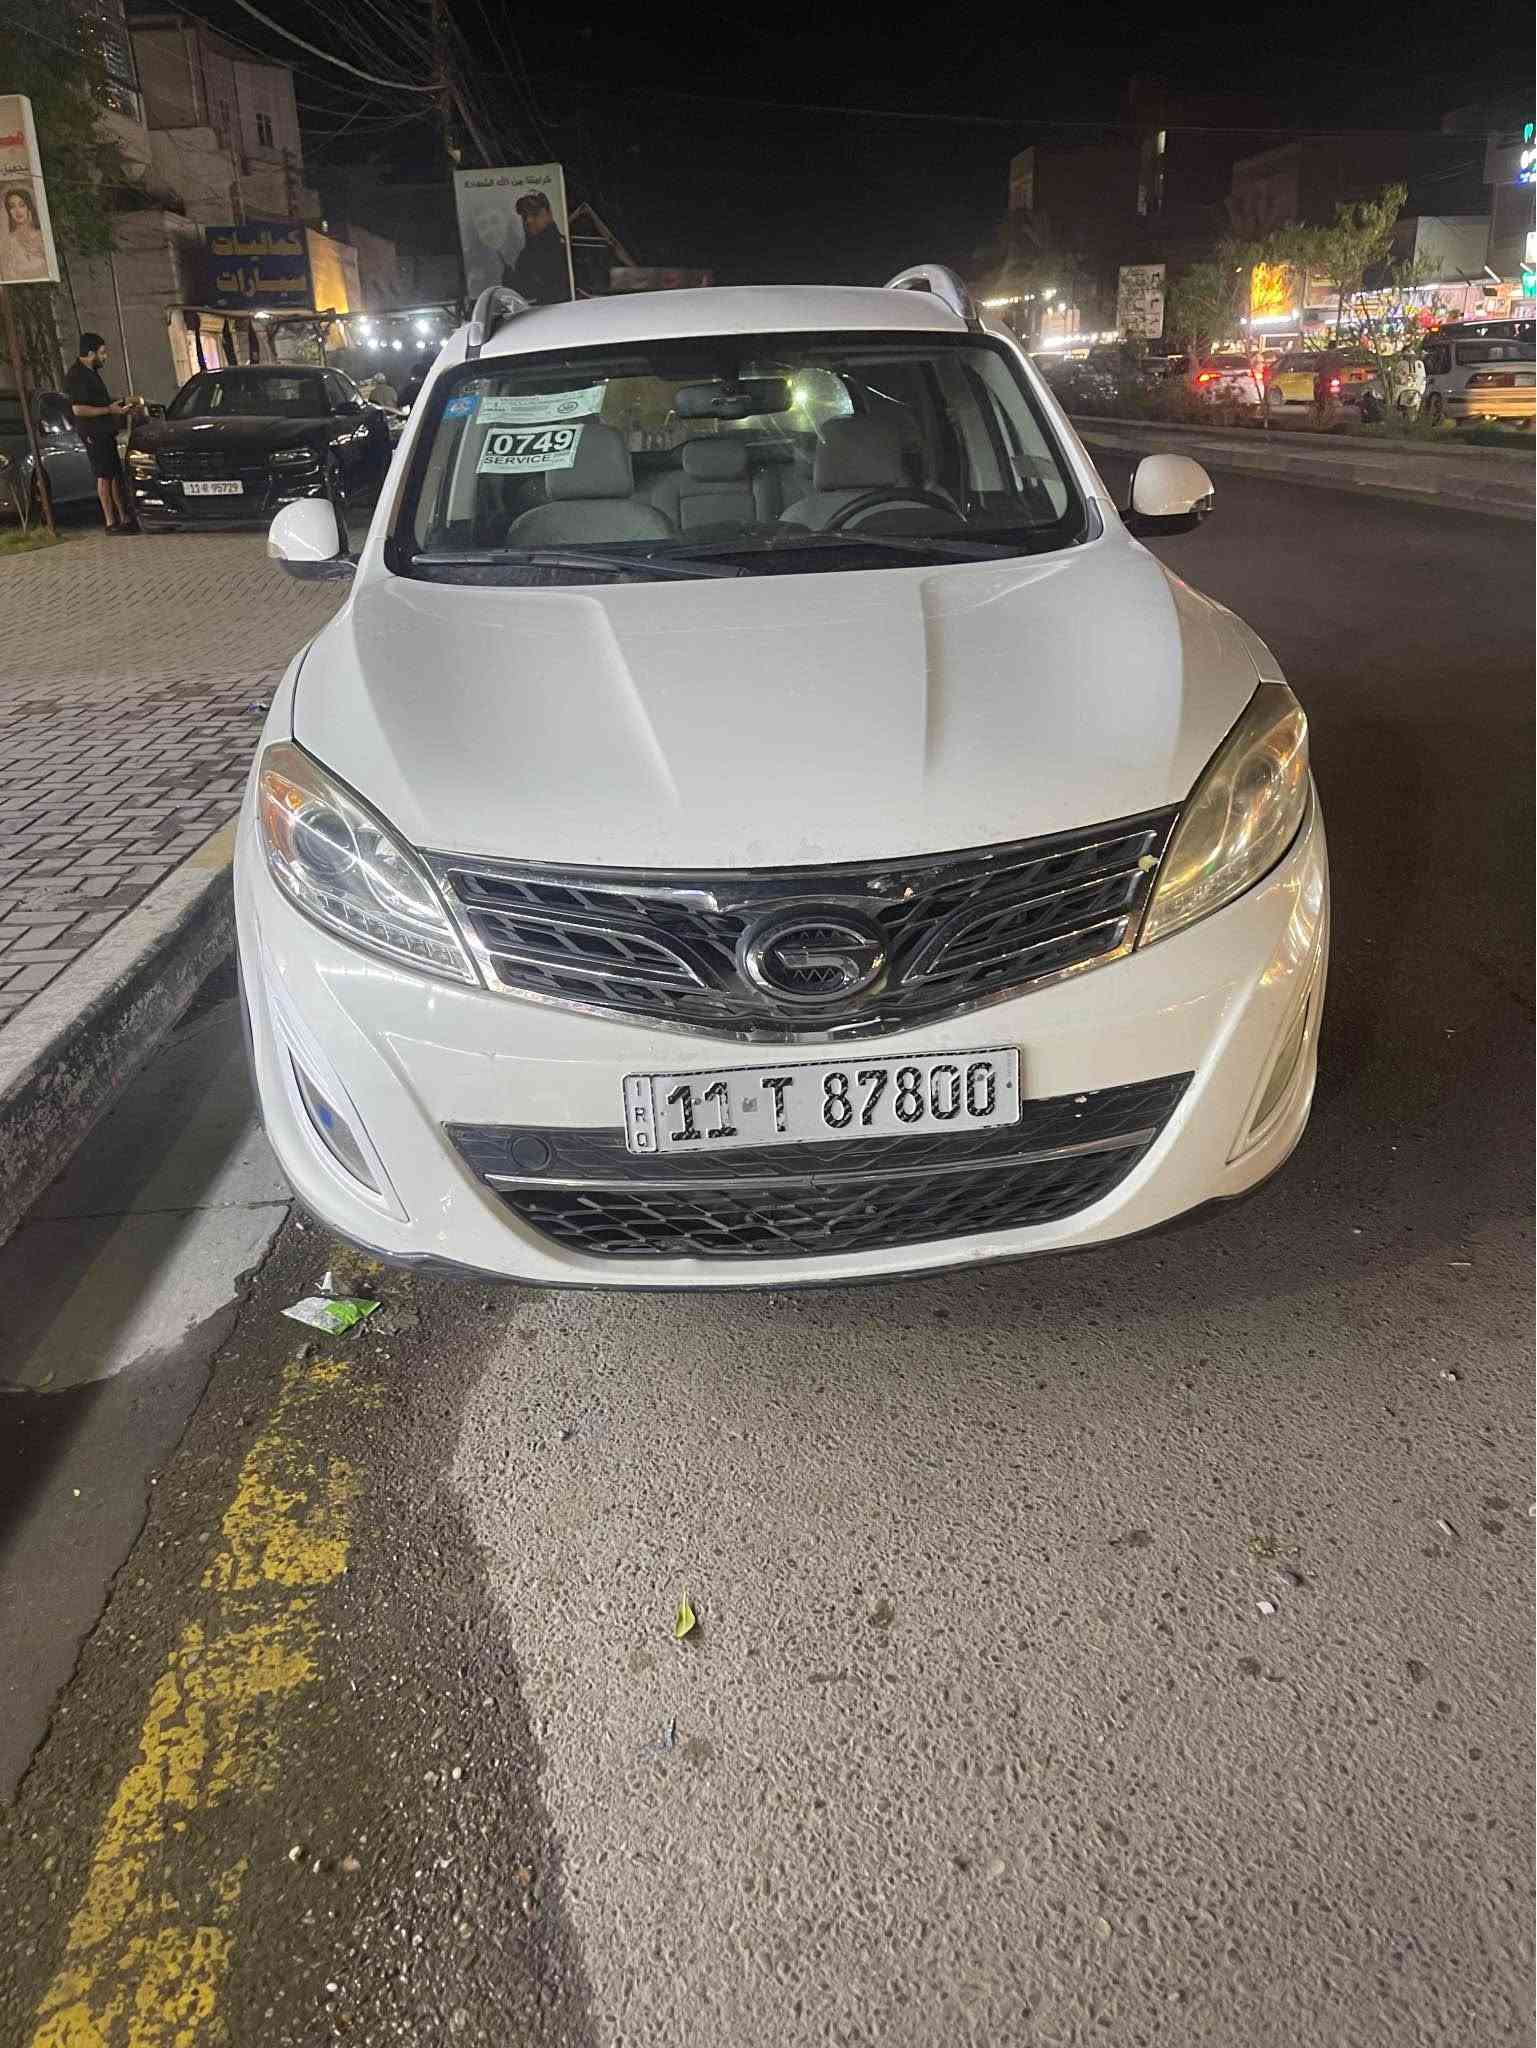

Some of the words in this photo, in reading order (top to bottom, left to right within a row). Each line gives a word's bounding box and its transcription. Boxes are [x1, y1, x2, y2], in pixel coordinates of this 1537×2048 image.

[483, 454, 551, 465] SERVICE
[667, 1081, 738, 1142] 11
[761, 1076, 794, 1133] T
[821, 1062, 997, 1130] 87800
